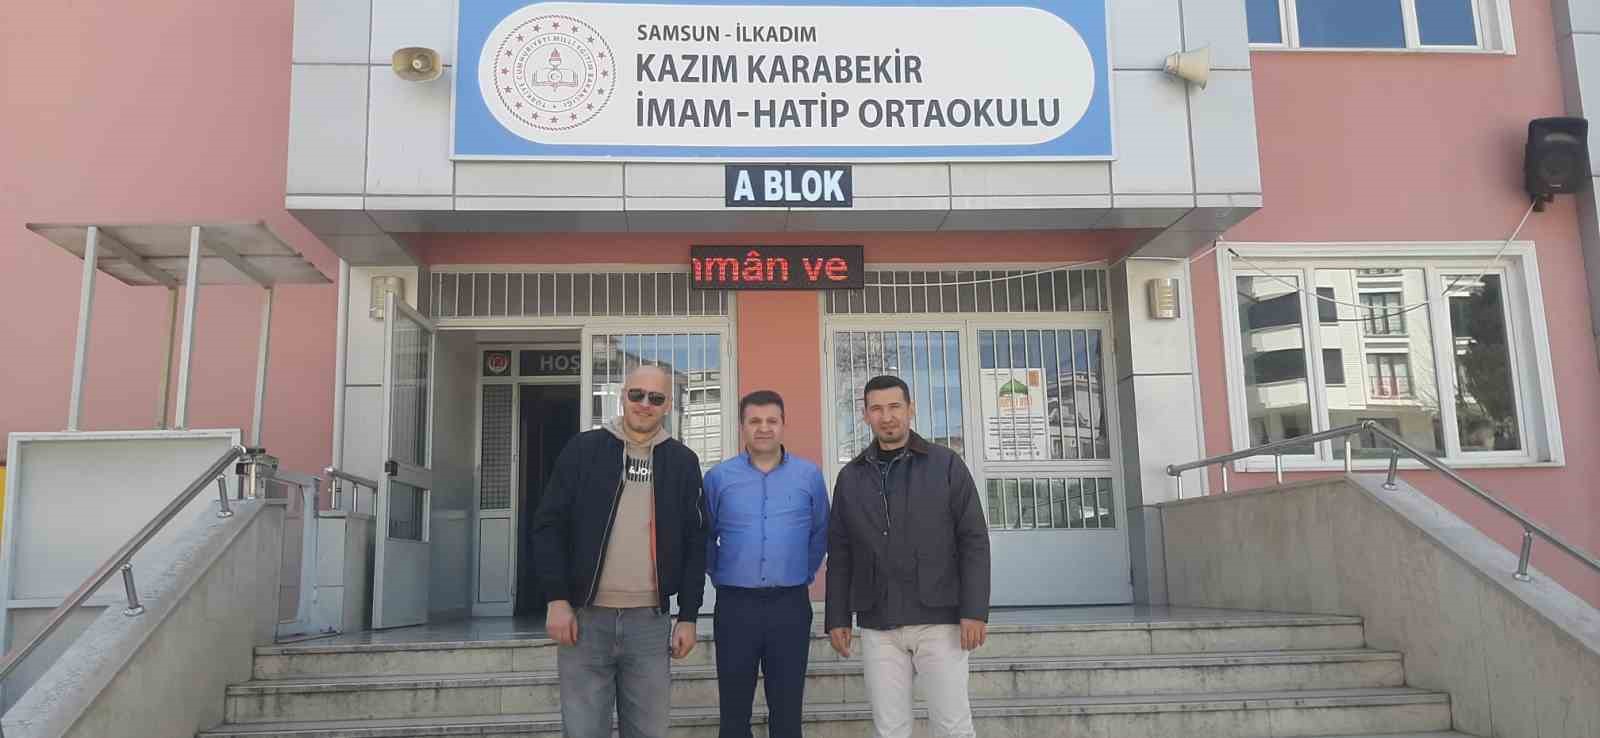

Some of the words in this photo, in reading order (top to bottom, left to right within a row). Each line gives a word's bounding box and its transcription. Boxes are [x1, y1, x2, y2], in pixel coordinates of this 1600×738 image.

[637, 25, 719, 42] SAMSUN
[736, 22, 817, 42] İLKADIM
[636, 54, 738, 83] KAZIM
[747, 49, 922, 84] KARABEKİR
[636, 90, 850, 128] İMAM-HATİP
[858, 98, 1060, 128] ORTAOKULU
[733, 170, 756, 201] A
[763, 169, 845, 202] BLOK
[802, 258, 848, 281] ve
